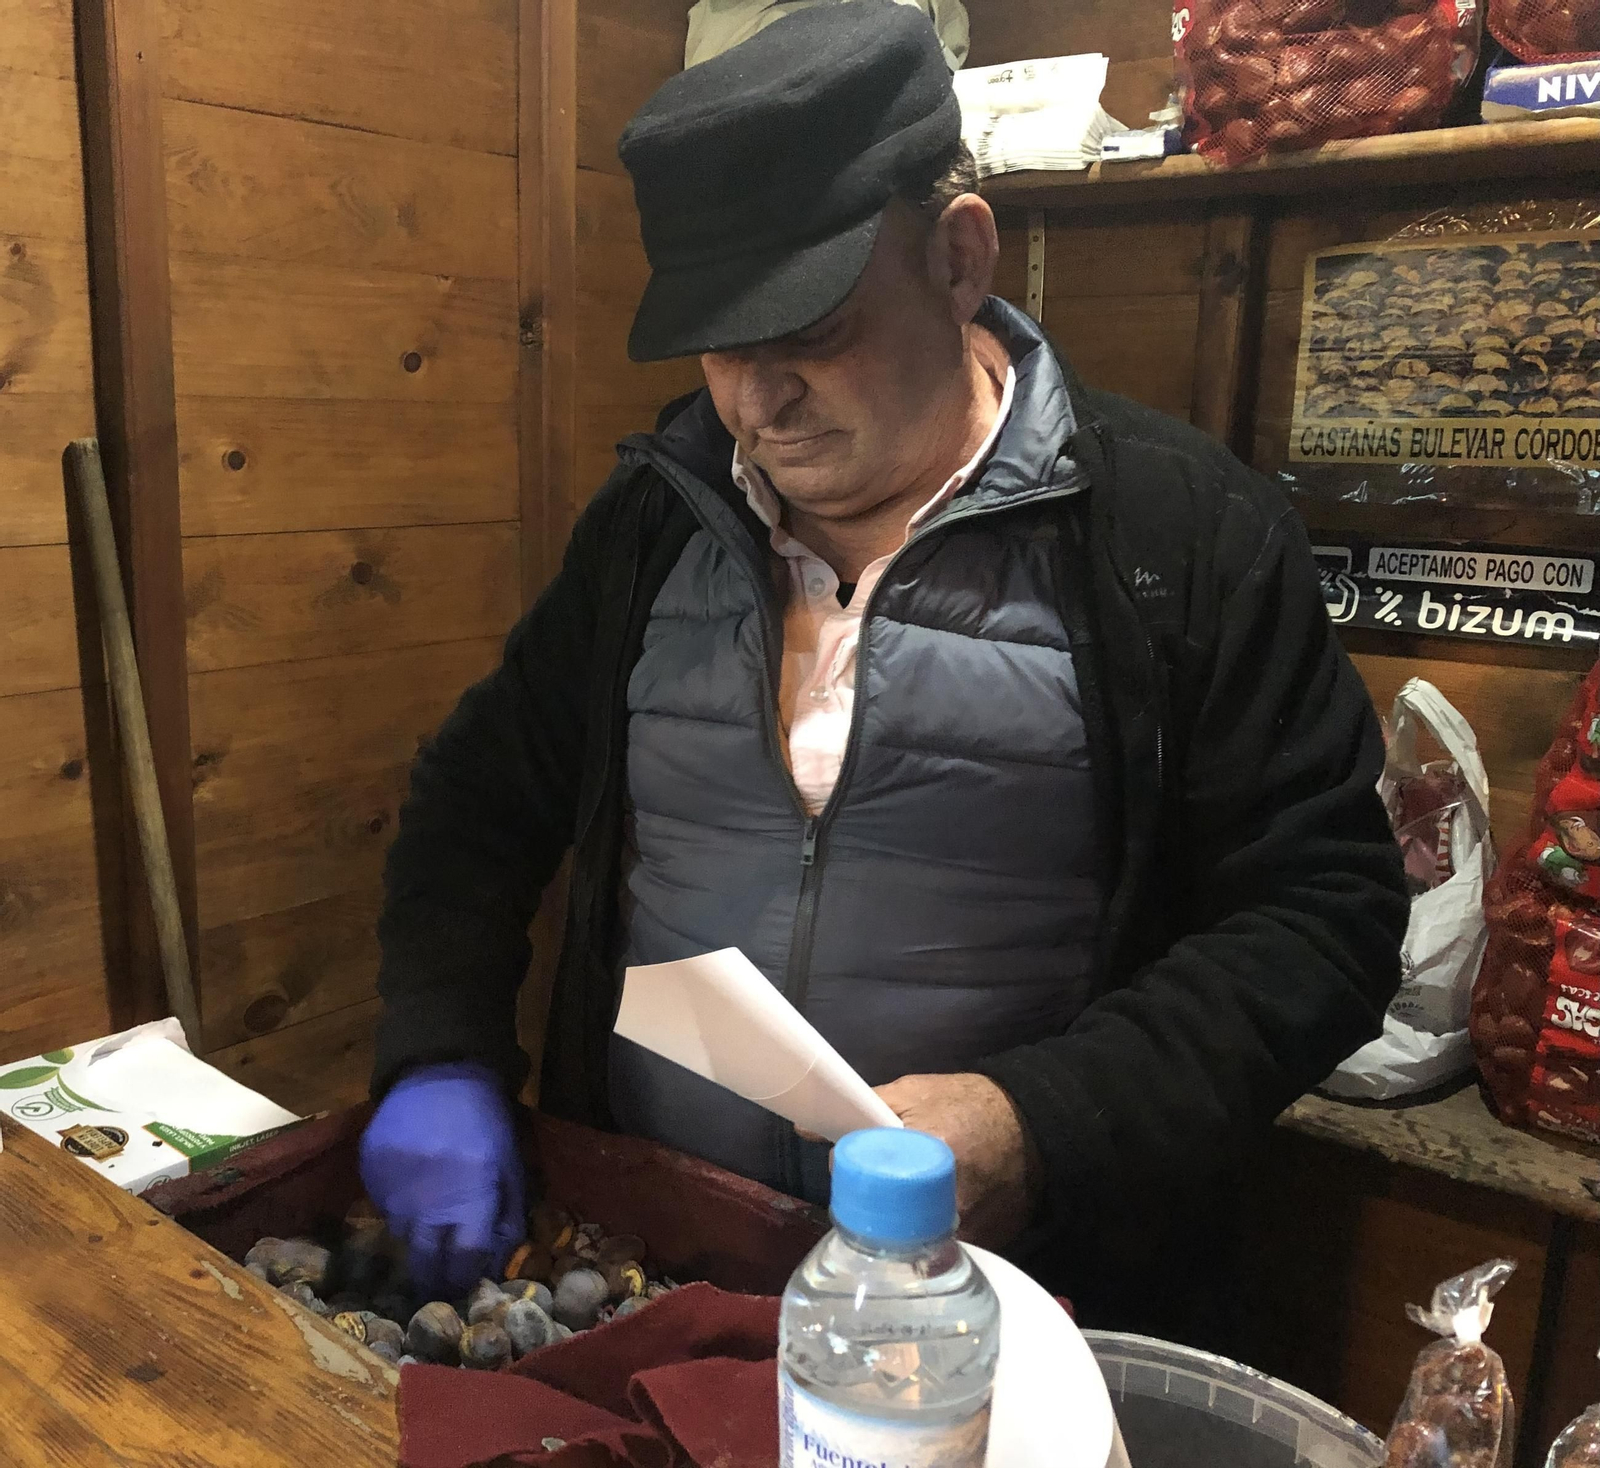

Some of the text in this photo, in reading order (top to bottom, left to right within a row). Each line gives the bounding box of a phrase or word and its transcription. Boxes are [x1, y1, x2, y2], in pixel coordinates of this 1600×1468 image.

[1538, 72, 1600, 103] NIV
[1300, 420, 1402, 457] CASTAÑAS
[1409, 427, 1505, 459] BULEVAR
[1375, 551, 1584, 588] ACEPTAMOS PAGO CON
[1418, 590, 1575, 642] bizum
